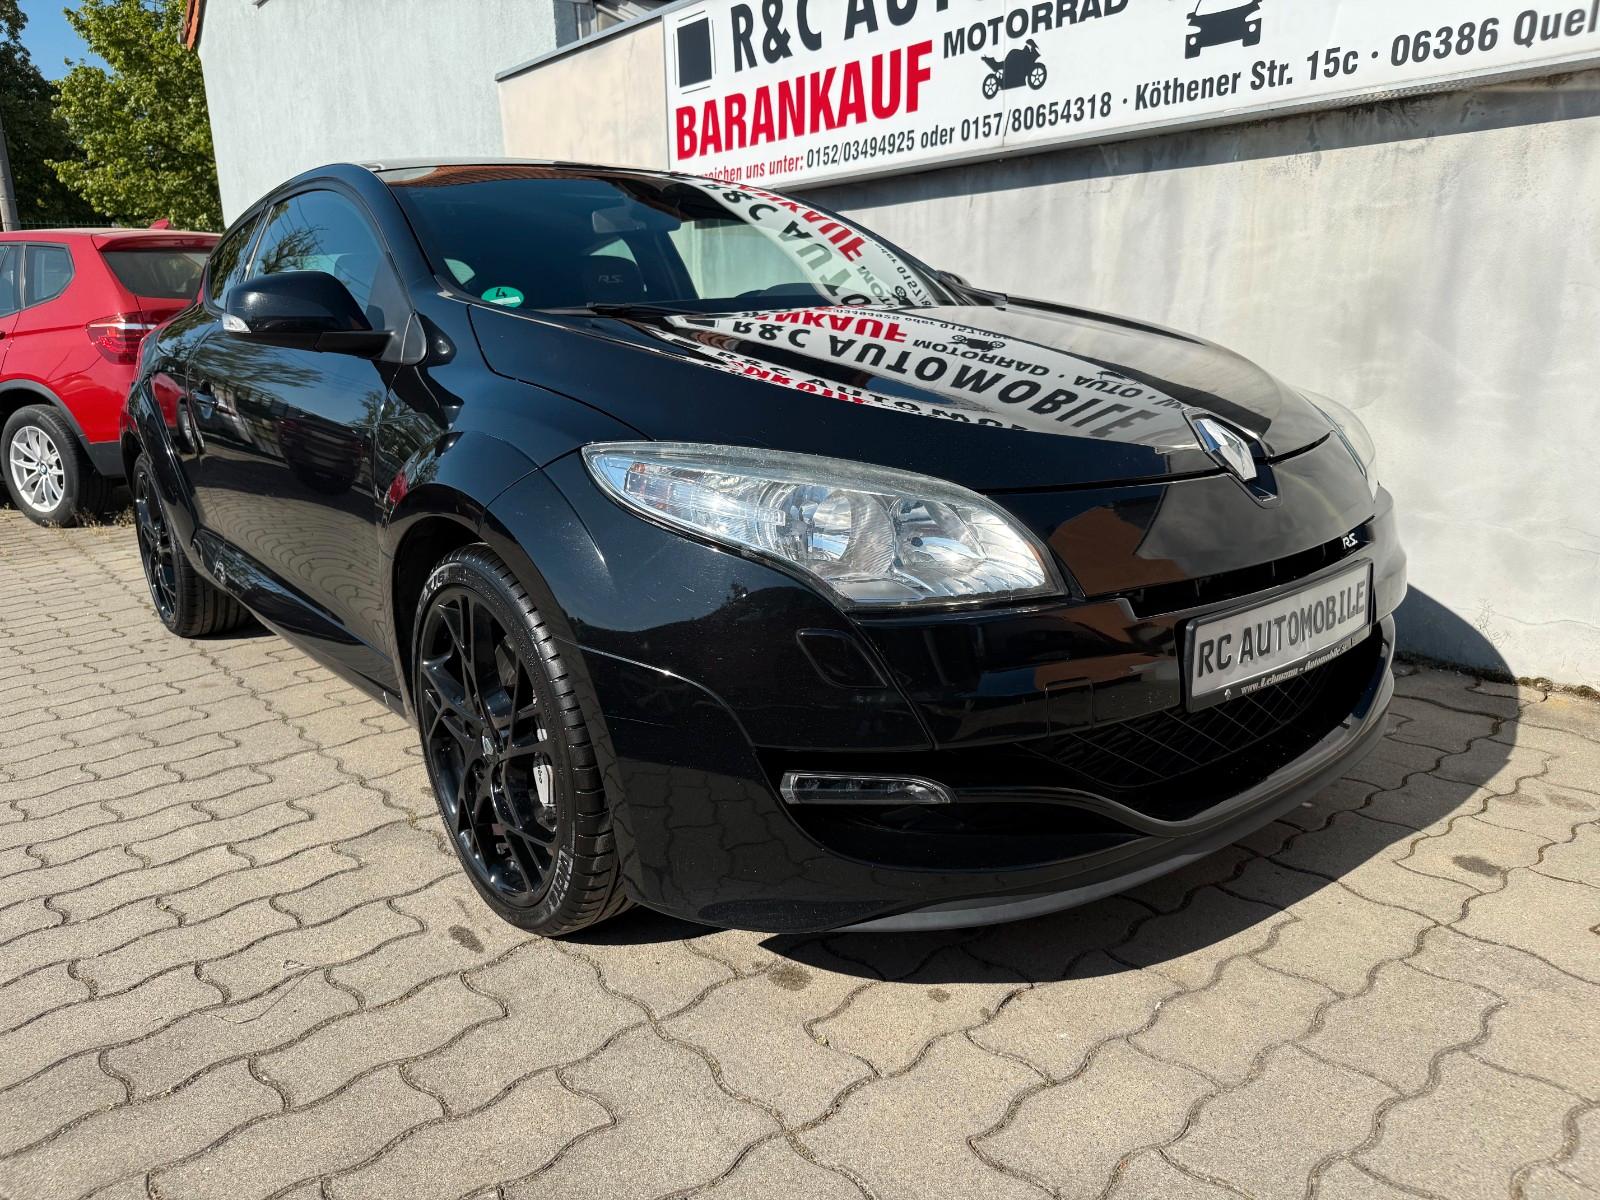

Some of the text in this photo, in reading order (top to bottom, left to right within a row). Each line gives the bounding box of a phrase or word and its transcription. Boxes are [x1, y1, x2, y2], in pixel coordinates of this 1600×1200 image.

[730, 0, 823, 73] R&C
[675, 40, 933, 161] BARANKAUF
[746, 162, 765, 179] uns
[769, 155, 804, 176] unter:
[806, 130, 915, 169] 0152/03494925
[920, 124, 956, 149] oder
[960, 91, 1112, 142] 0157/80654318
[1134, 71, 1242, 111] Köthener
[1249, 59, 1294, 91] Str.
[1306, 47, 1359, 81] 15c
[1390, 17, 1500, 67] 06386
[495, 287, 507, 298] 4
[1197, 580, 1366, 678] RC AUTOMOBILE
